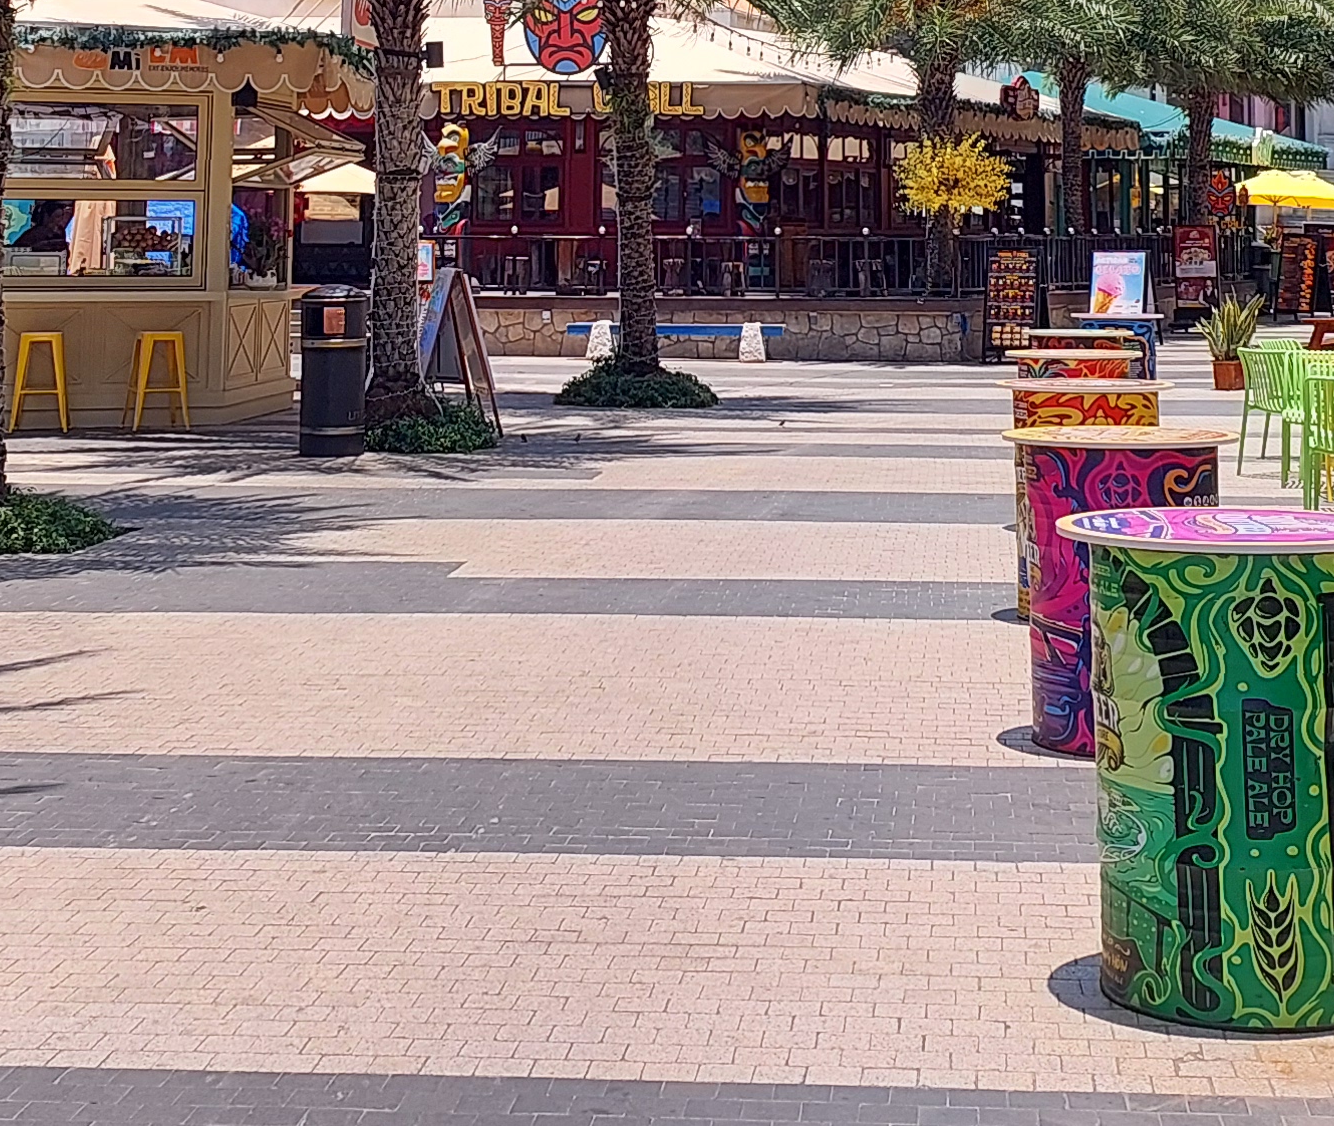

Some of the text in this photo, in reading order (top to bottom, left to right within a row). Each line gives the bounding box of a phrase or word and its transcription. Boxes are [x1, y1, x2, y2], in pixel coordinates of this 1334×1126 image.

[431, 81, 704, 116] TRIBAL GILL
[1245, 711, 1270, 828] PALE ALE
[1269, 714, 1293, 825] DRY HOP
